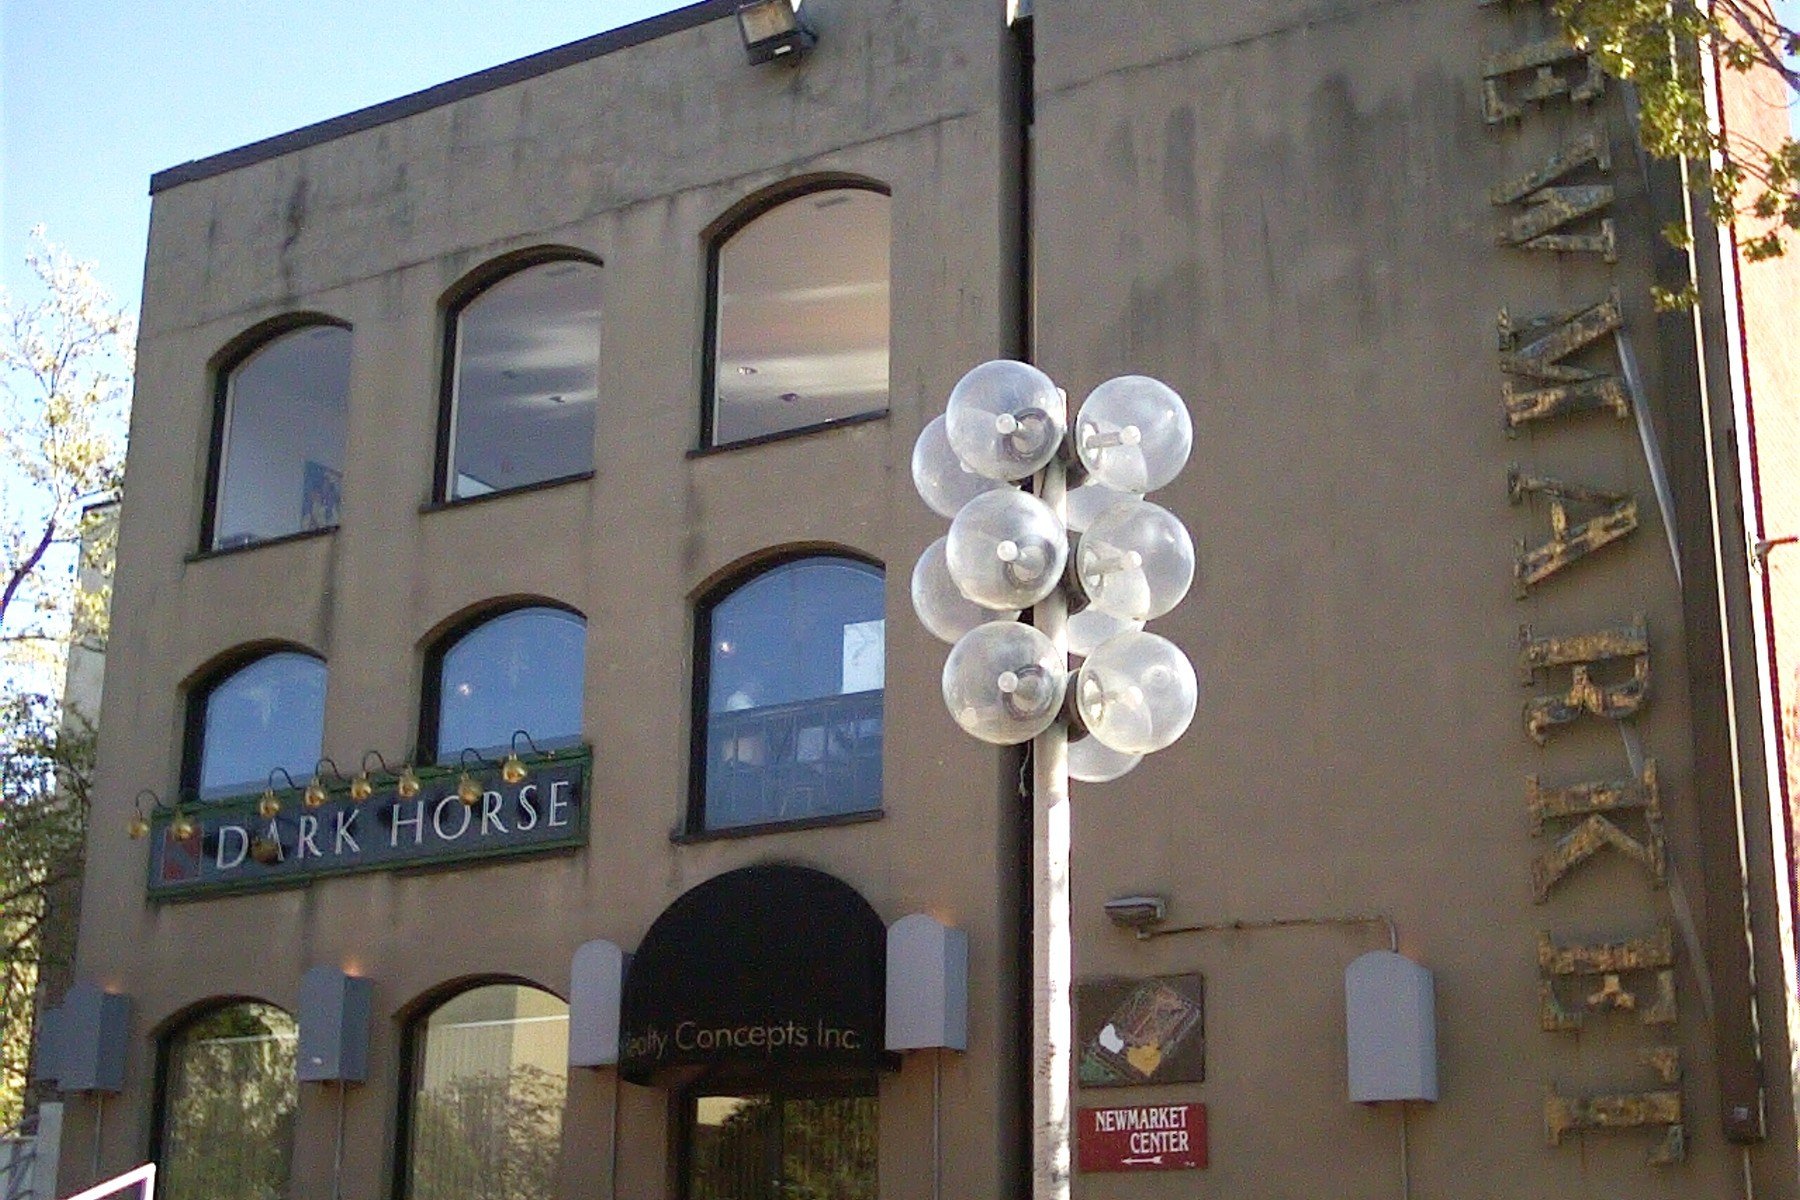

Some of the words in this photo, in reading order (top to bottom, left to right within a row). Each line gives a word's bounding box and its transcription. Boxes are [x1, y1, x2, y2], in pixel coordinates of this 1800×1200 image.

[216, 808, 361, 870] DARK
[390, 780, 570, 847] HORSE
[675, 1020, 808, 1052] Concepts
[817, 1018, 861, 1050] Inc.
[1095, 1106, 1189, 1132] NEWMARKET
[1129, 1131, 1189, 1154] CENTER
